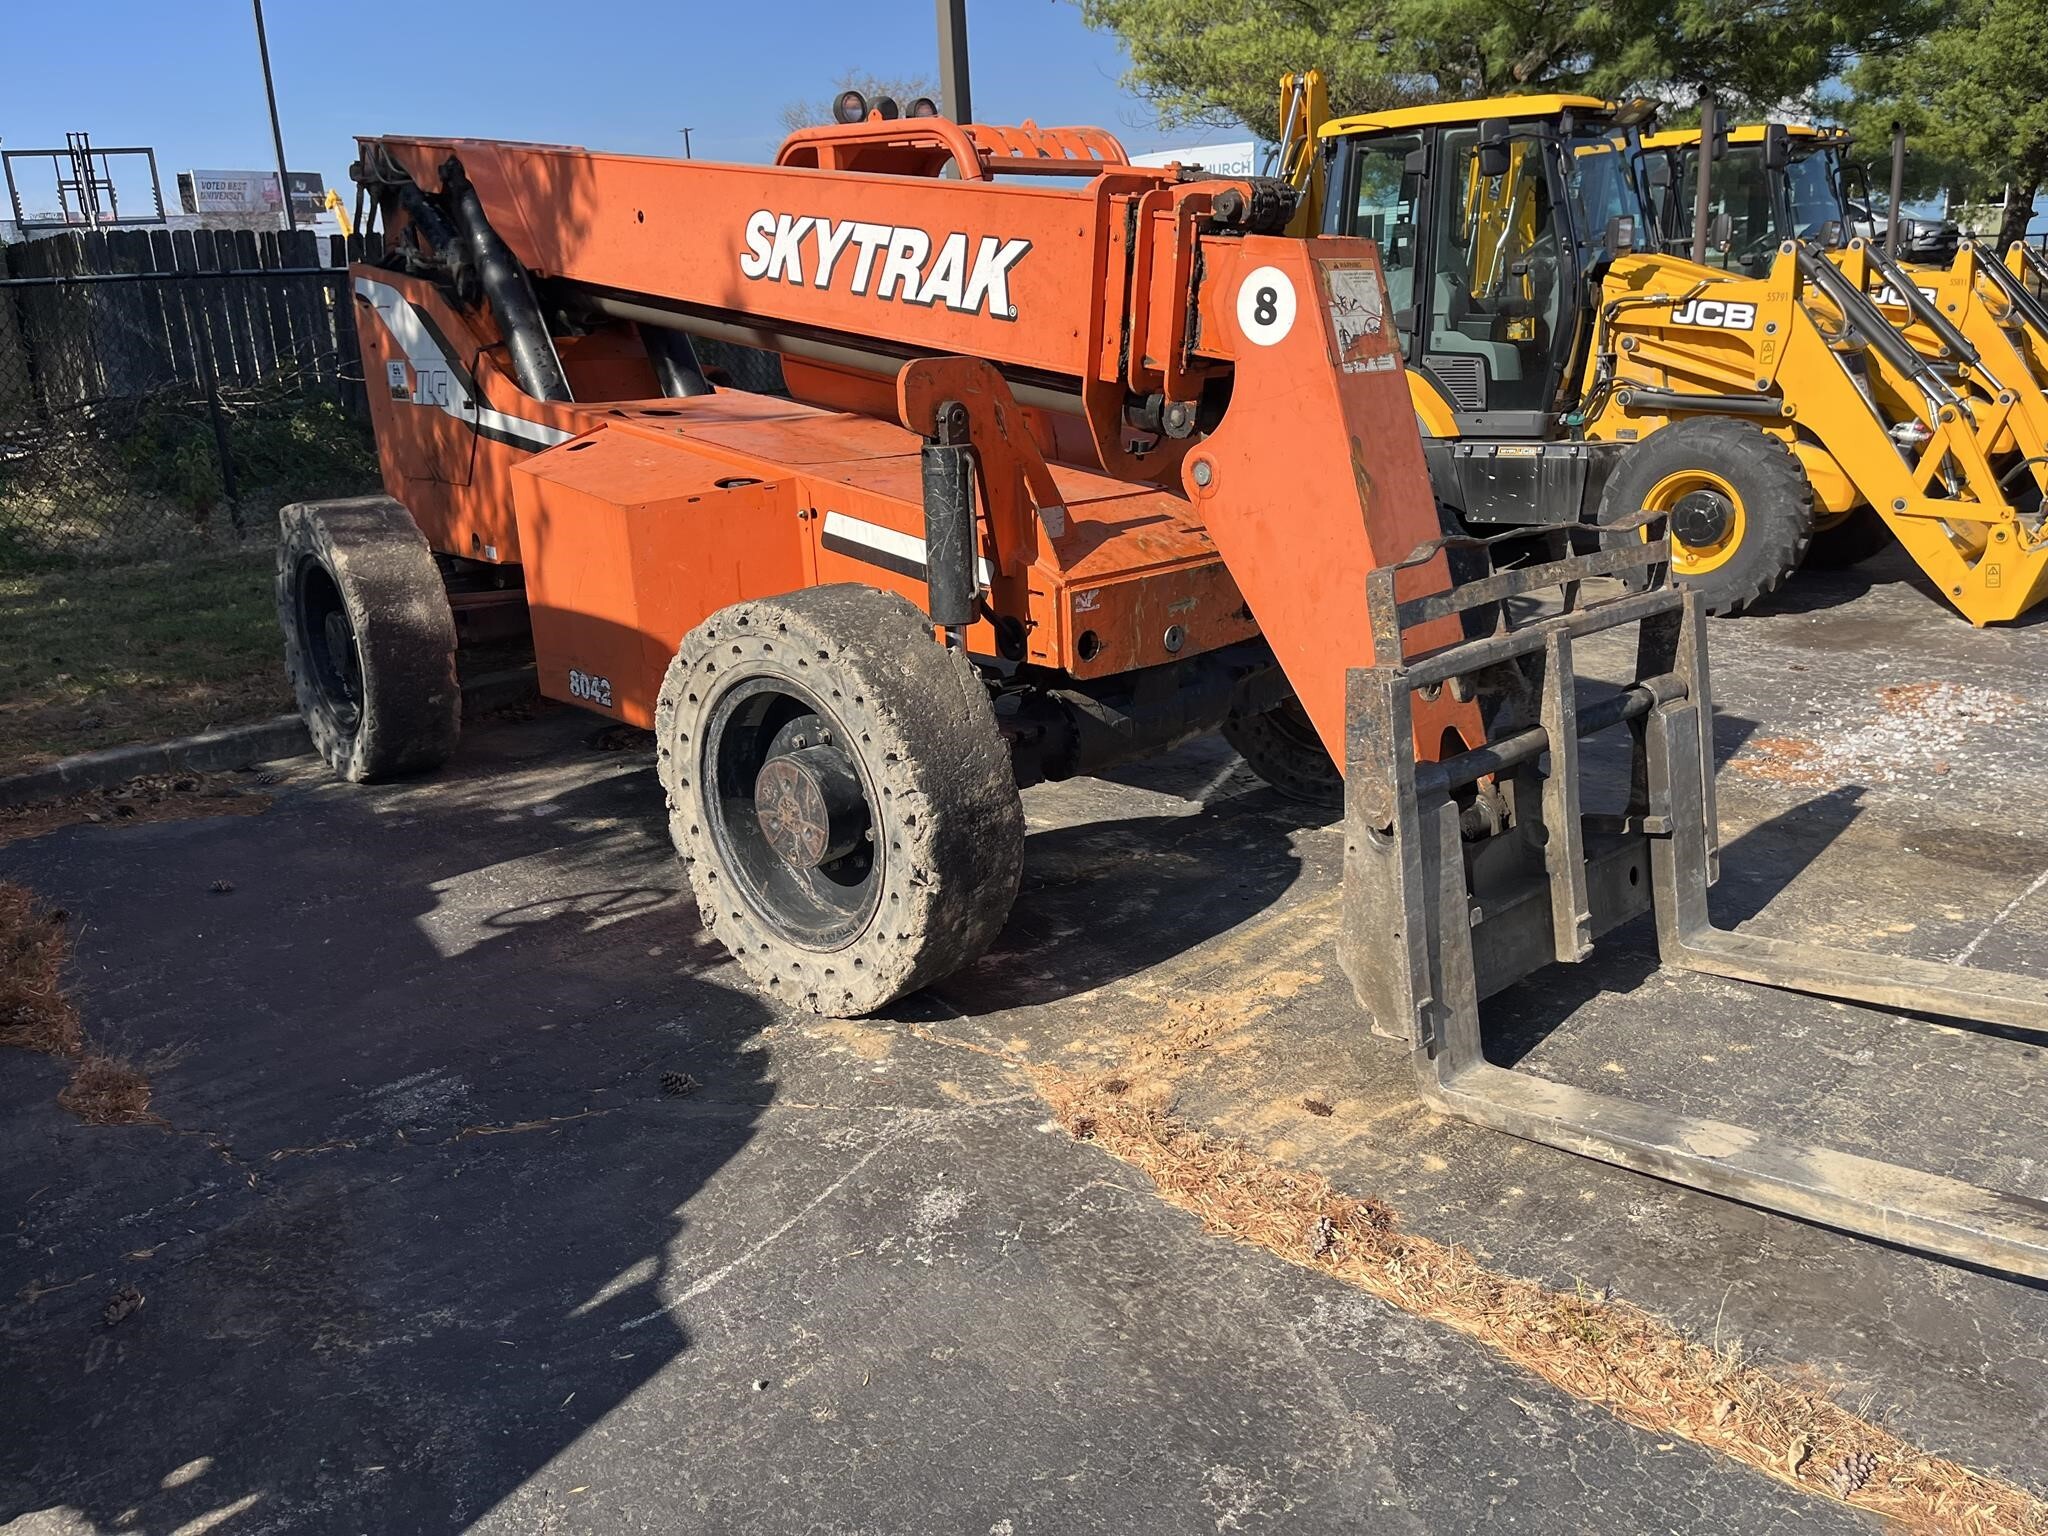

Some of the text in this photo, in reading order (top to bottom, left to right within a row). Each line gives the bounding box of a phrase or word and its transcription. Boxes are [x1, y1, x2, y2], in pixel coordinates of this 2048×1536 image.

[201, 181, 226, 190] VOTED
[1203, 161, 1251, 175] HURCH
[740, 209, 1033, 321] SKYTRAK
[1254, 286, 1278, 326] 8
[1672, 300, 1755, 329] JCB
[412, 370, 449, 406] JLG
[568, 668, 612, 708] 8042
